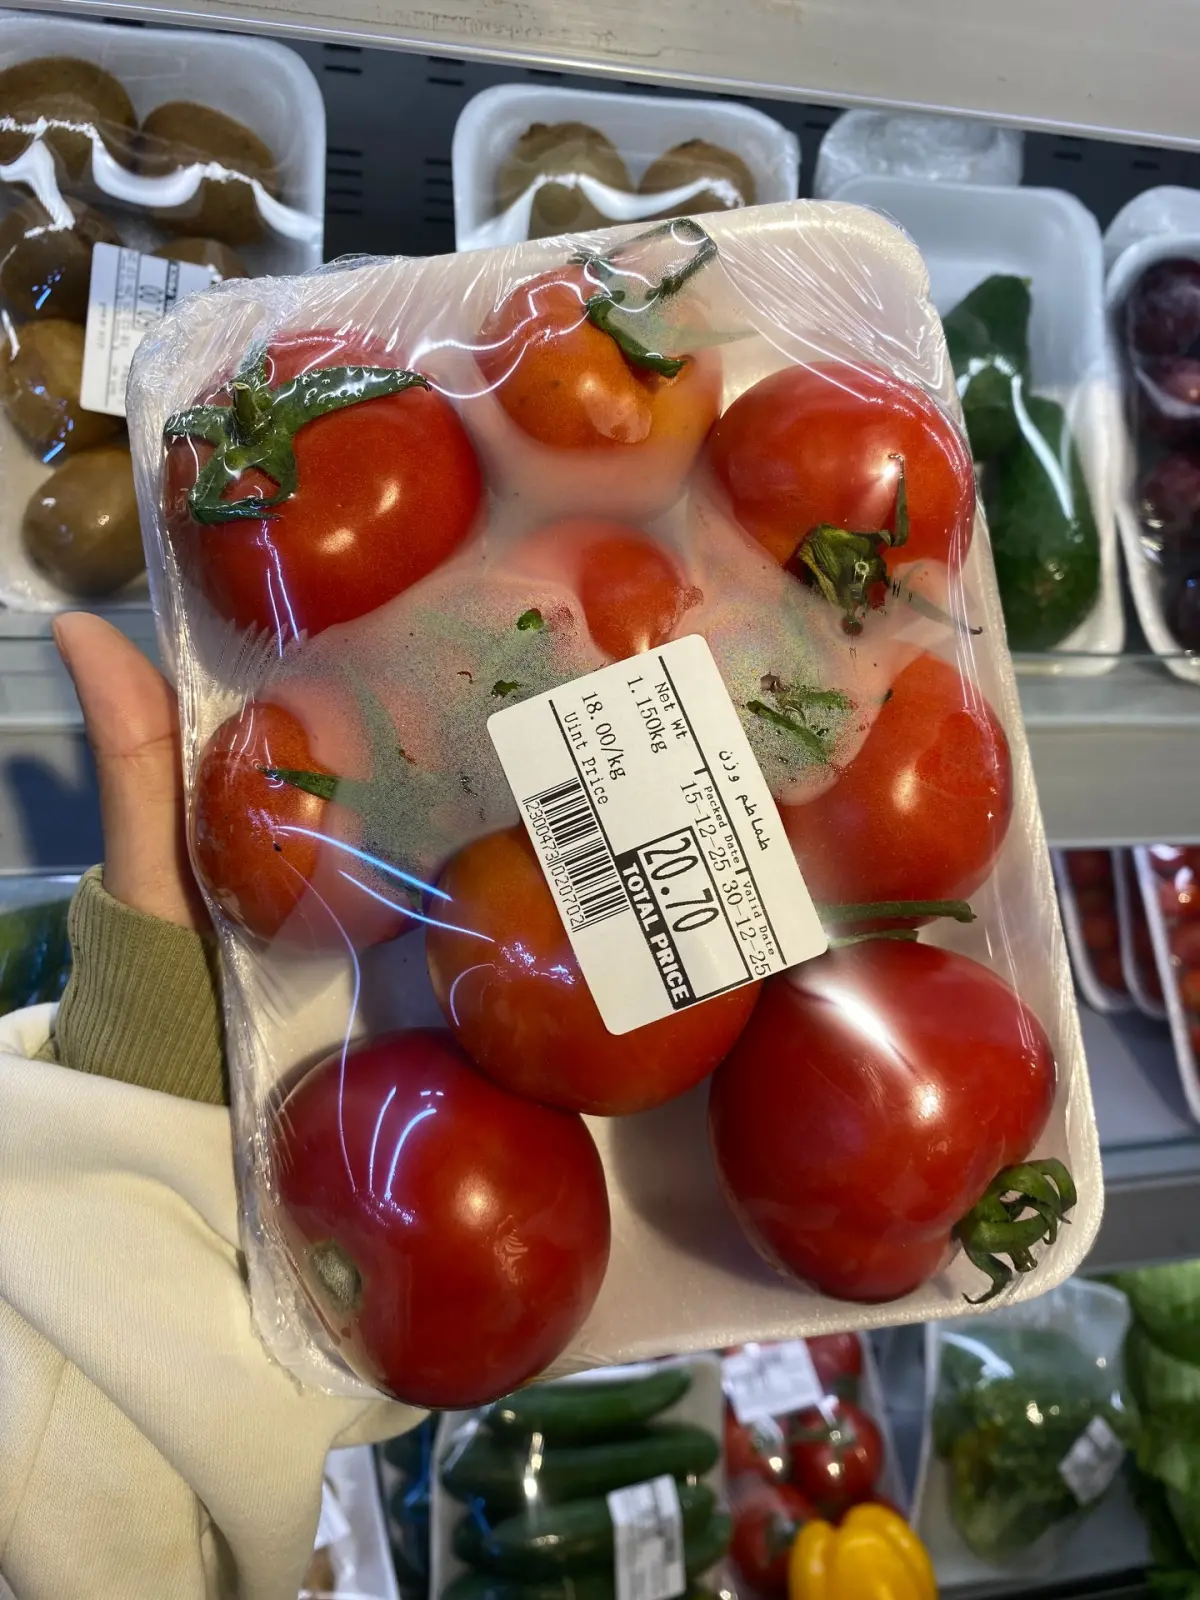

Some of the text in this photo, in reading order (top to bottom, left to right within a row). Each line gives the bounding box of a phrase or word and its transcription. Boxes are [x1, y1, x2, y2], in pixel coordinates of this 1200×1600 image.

[654, 681, 687, 739] Net Wt
[563, 711, 609, 805] Uint Price
[718, 750, 740, 783] وزن
[680, 781, 731, 871] 15-12-25
[704, 785, 740, 864] Packed Date
[643, 837, 719, 932] 20.70
[722, 879, 771, 976] 30-12-25
[743, 880, 775, 956] Valid Date
[622, 862, 690, 1003] TOTAL PRICE
